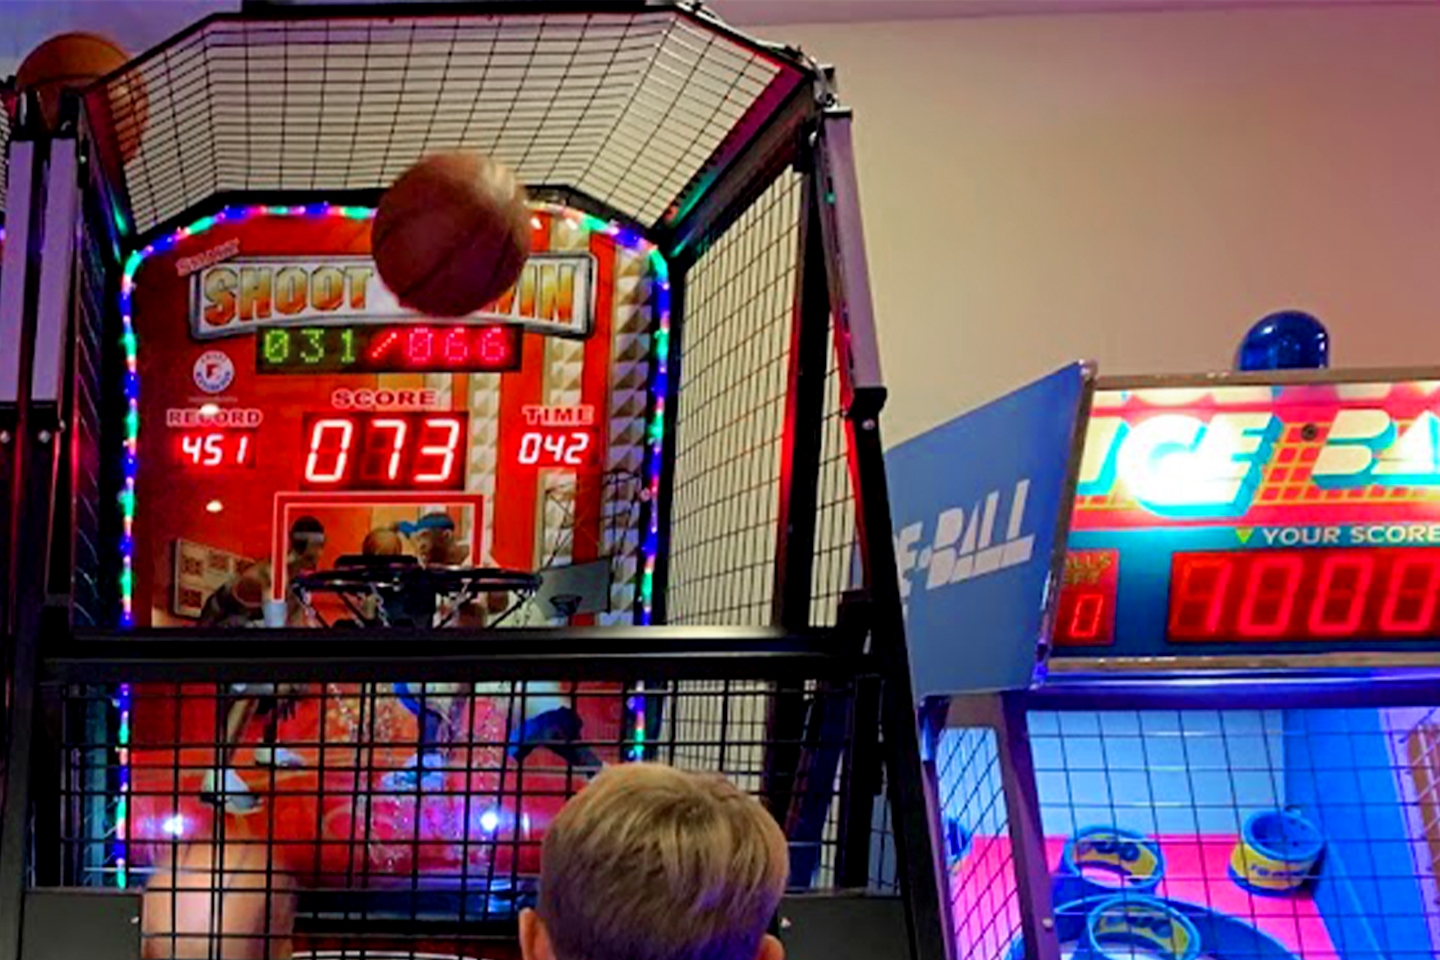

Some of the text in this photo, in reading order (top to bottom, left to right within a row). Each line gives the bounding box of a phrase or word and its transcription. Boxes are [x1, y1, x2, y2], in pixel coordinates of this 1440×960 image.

[202, 265, 374, 327] SHOOT
[331, 389, 436, 408] SCORE
[521, 405, 594, 426] TIME
[181, 435, 249, 465] 451
[304, 418, 461, 482] 073
[517, 433, 589, 465] 042
[1312, 408, 1440, 490] BA
[1262, 523, 1440, 546] YOUR SCORE
